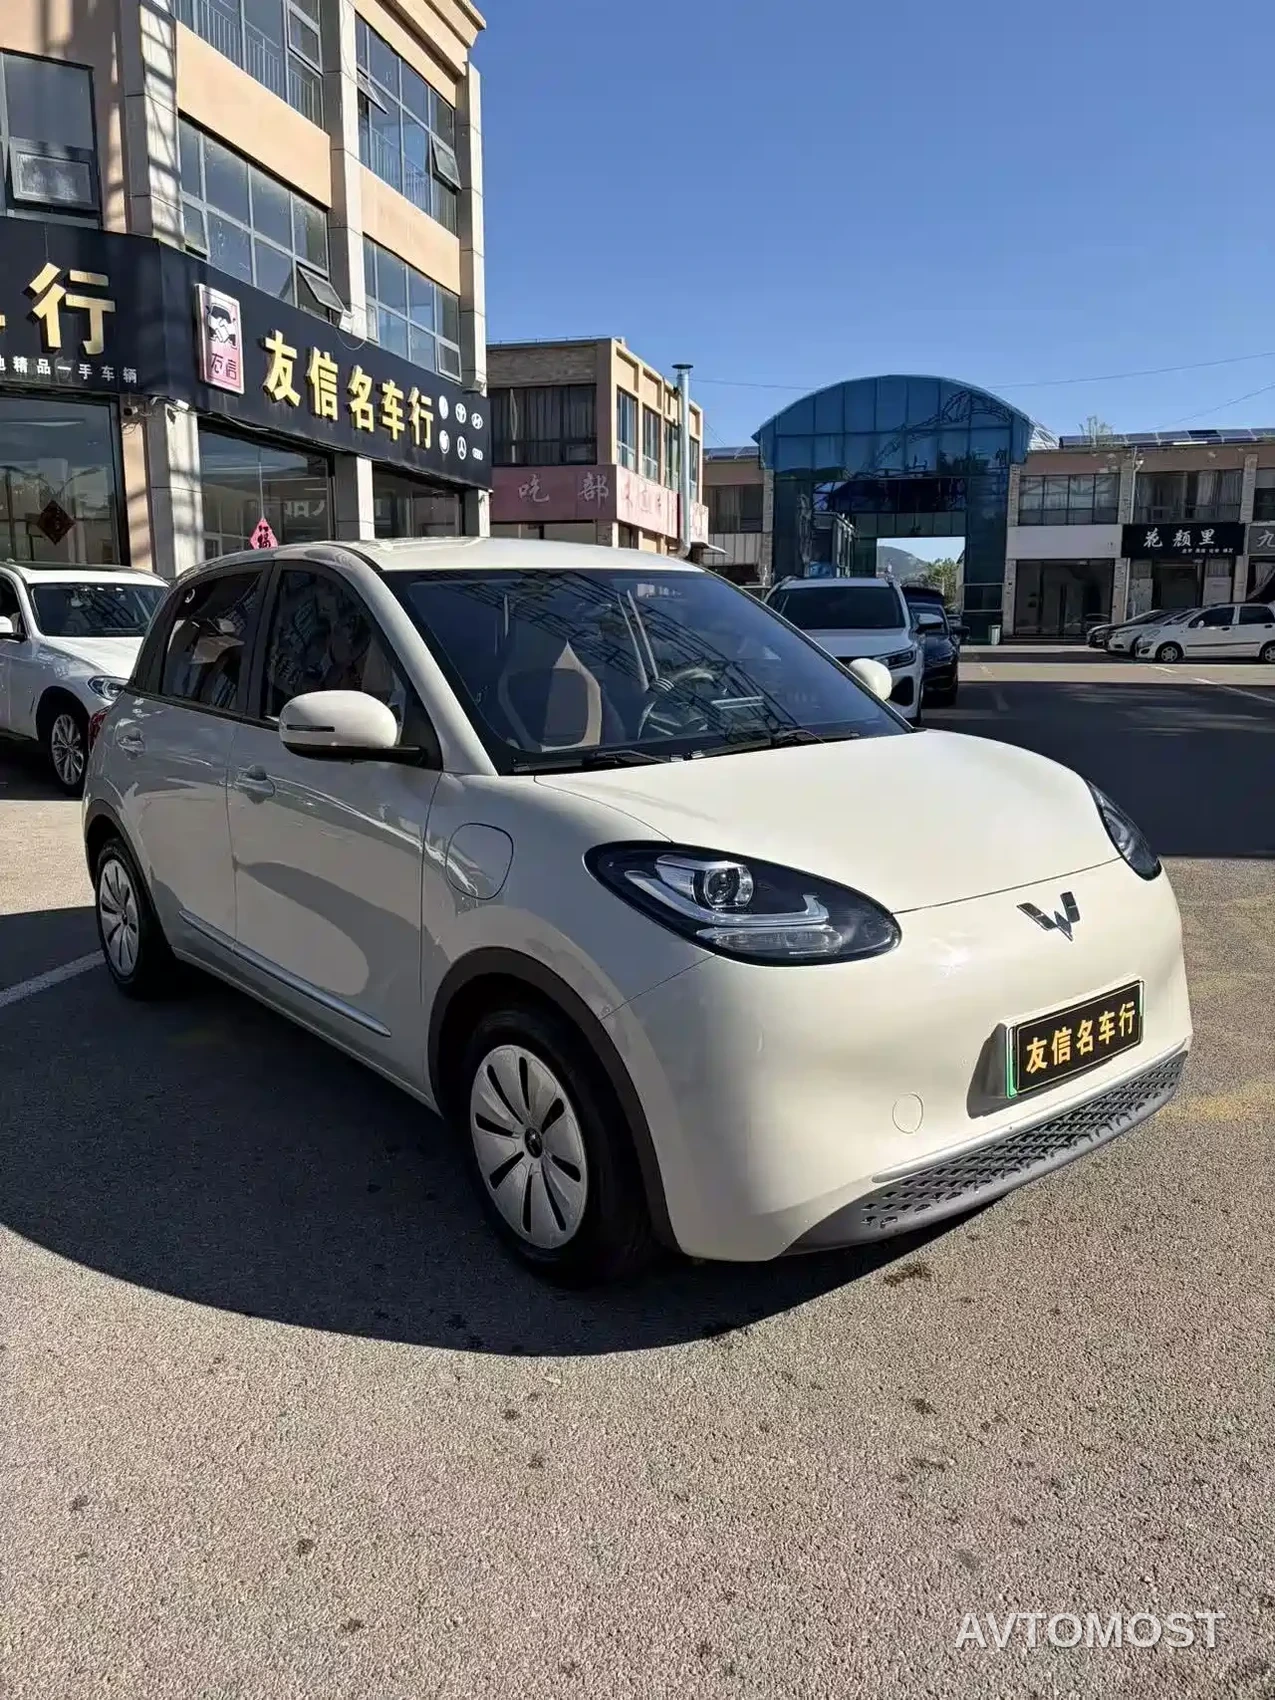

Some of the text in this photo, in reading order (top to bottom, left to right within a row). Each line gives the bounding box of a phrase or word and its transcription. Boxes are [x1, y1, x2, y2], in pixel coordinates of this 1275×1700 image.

[0, 262, 116, 355] 行
[262, 329, 434, 449] 友信名车行
[1143, 527, 1215, 548] 花颜里
[1026, 1001, 1136, 1073] 友信名车行
